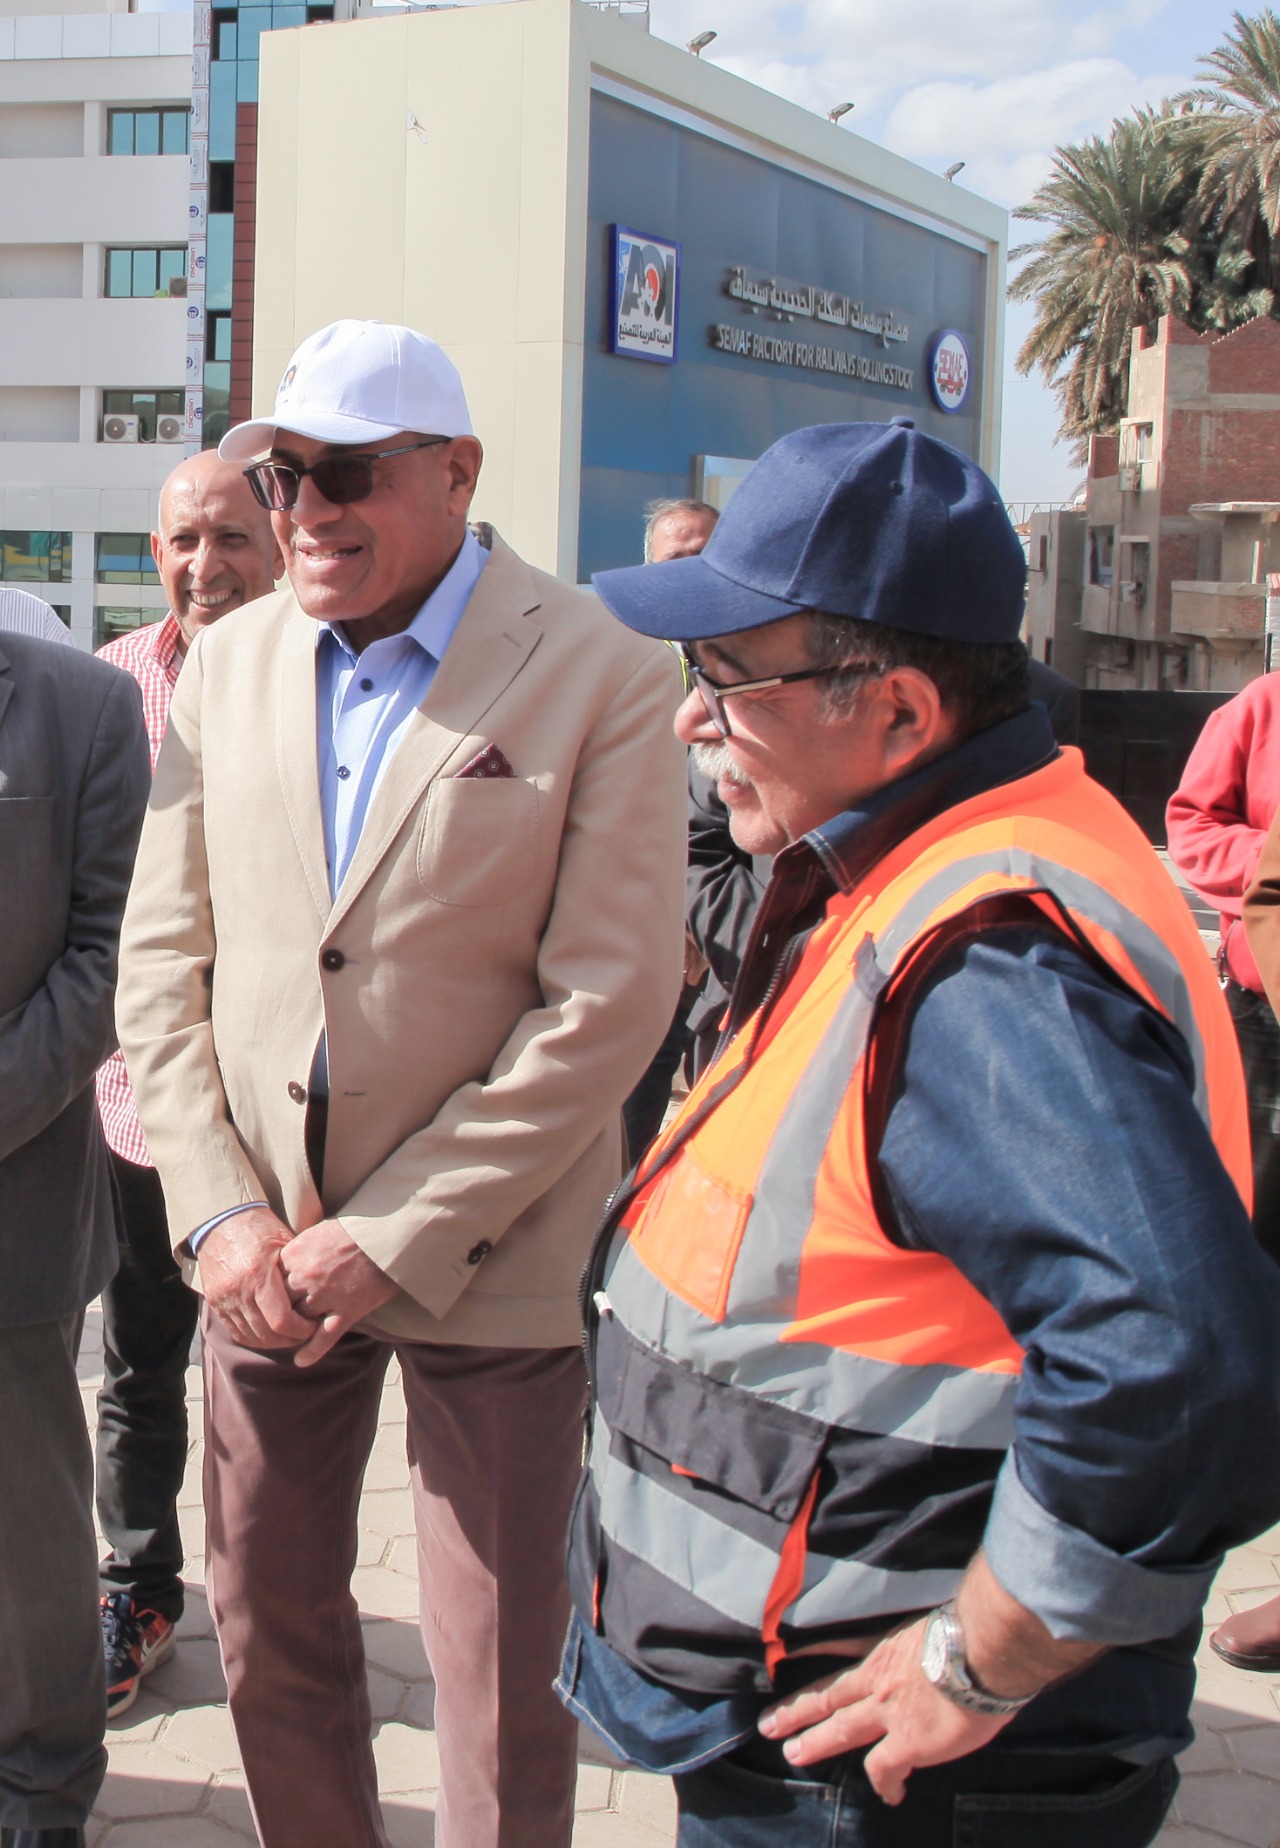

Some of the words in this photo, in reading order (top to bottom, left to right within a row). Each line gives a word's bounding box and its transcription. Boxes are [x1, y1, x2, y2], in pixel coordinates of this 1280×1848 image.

[771, 279, 815, 322] الحديدية
[818, 291, 849, 326] السكك
[851, 302, 883, 336] مهمات
[882, 311, 909, 349] مصنع
[716, 323, 752, 355] SEMAF
[753, 334, 795, 365] FACTORY
[796, 343, 815, 368] FOR
[816, 346, 856, 376] RAILWAYS
